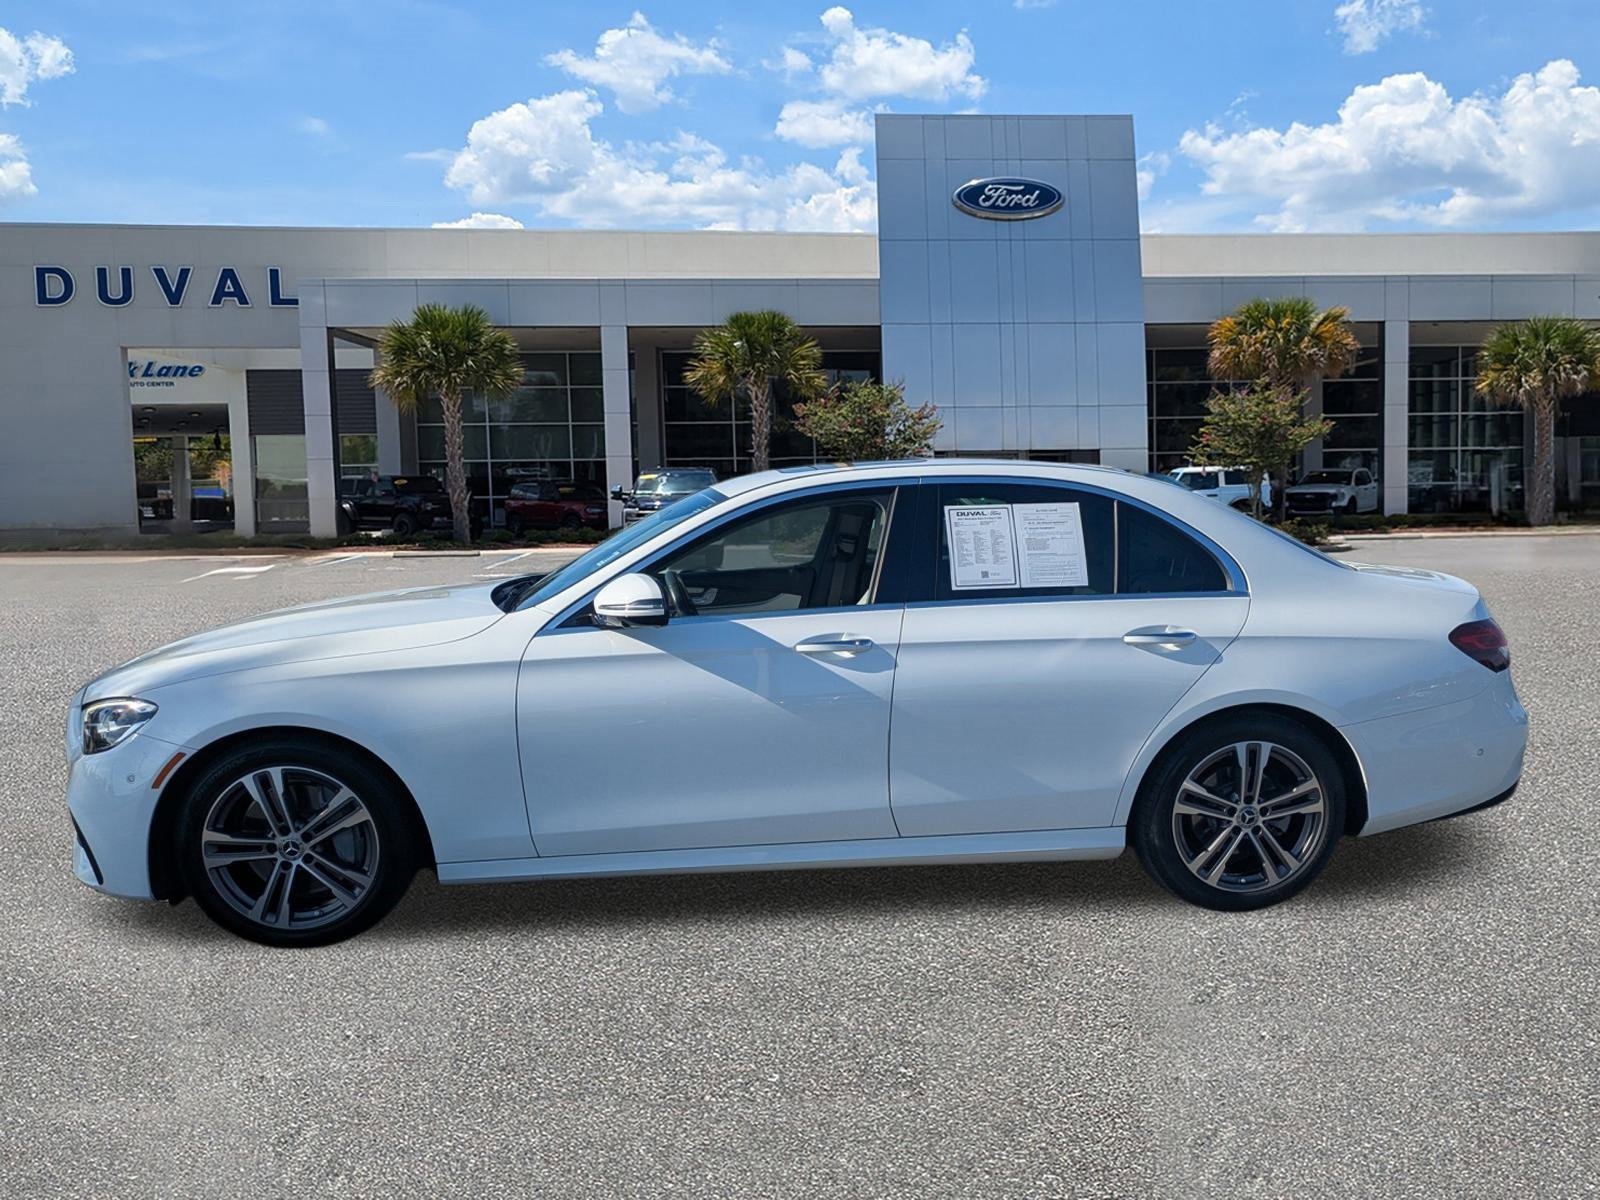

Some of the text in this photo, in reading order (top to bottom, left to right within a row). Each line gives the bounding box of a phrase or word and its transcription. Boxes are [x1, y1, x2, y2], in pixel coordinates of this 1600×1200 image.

[979, 184, 1040, 207] Ford
[33, 265, 299, 307] DUVAL
[141, 361, 205, 378] Lane
